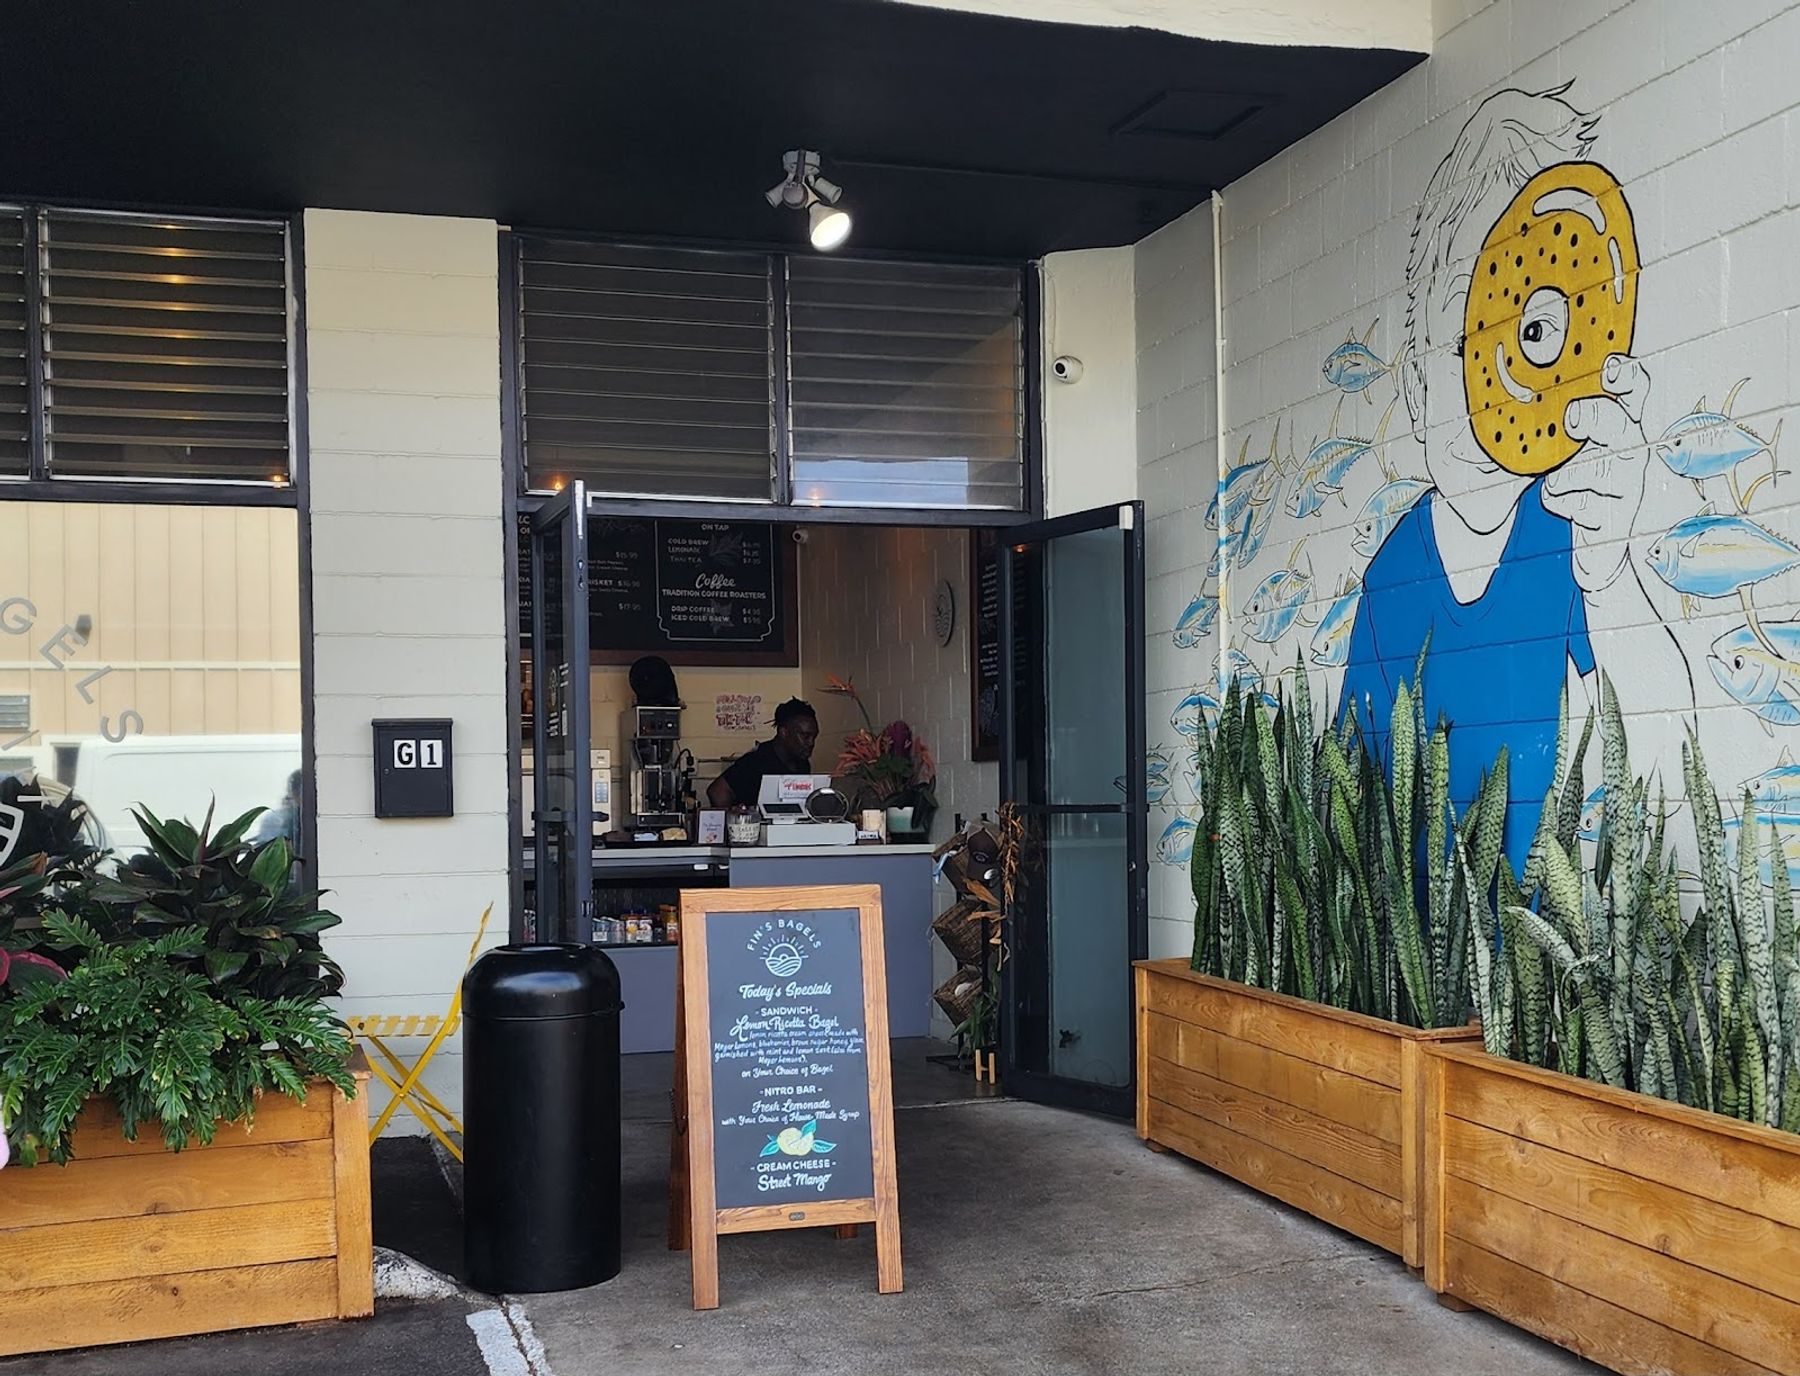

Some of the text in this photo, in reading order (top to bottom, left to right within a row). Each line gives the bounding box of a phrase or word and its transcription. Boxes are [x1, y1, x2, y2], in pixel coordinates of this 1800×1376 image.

[695, 573, 736, 589] Coffee
[662, 589, 700, 597] TRADITION
[730, 591, 766, 599] ROASTERS
[397, 742, 437, 765] G1
[747, 919, 822, 951] FIN'S BAGELS
[739, 981, 832, 1002] Today's Specials
[760, 1005, 813, 1017] SANDWICH
[729, 1014, 839, 1042] Lemon Ricotta Bagel
[741, 1063, 834, 1078] on Your Choice of Bagel
[764, 1084, 817, 1097] NITRO BAR
[751, 1098, 832, 1114] Fresh Lemonade
[721, 1117, 737, 1125] with
[758, 1114, 779, 1123] Choice
[780, 1114, 789, 1124] of
[838, 1109, 861, 1121] Syrup
[756, 1159, 830, 1172] CREAM CHEESE
[757, 1172, 832, 1192] Street Mango
